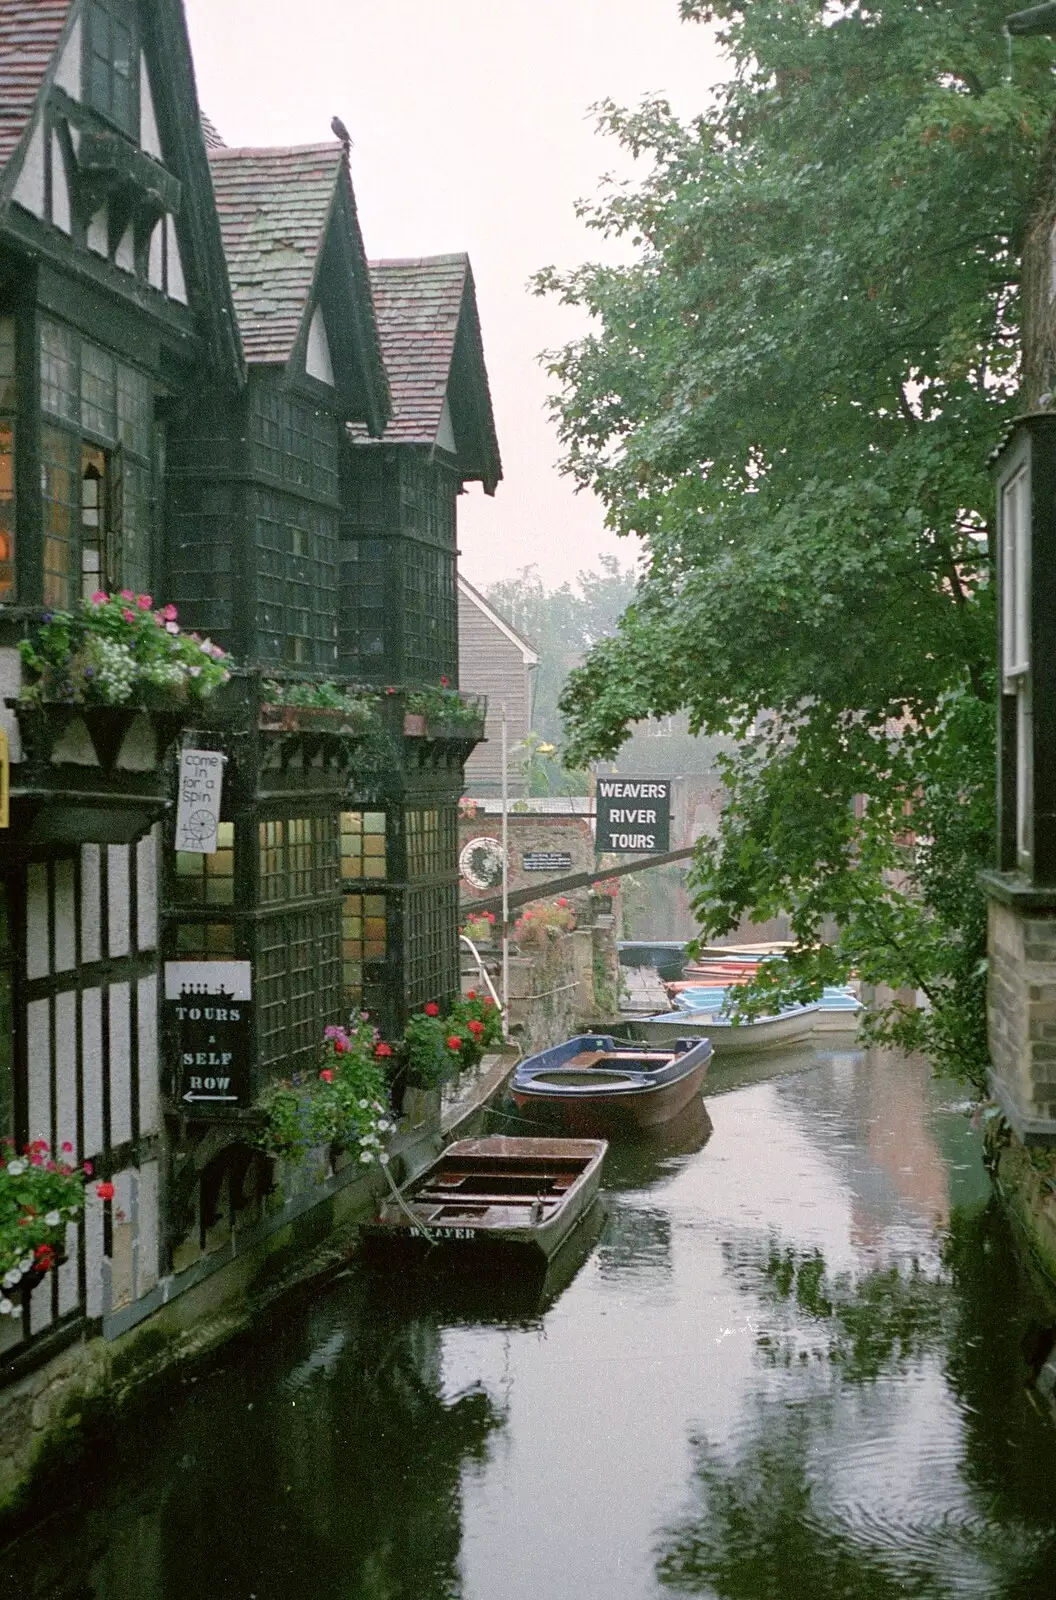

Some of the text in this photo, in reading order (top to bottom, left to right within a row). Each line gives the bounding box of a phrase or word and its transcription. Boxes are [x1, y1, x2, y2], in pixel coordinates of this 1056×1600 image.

[185, 755, 218, 767] come
[183, 776, 215, 789] for a
[600, 783, 666, 798] WEAVERS
[183, 790, 212, 808] spin
[609, 809, 656, 823] RIVER
[609, 833, 655, 848] TOURS
[175, 1007, 240, 1021] TOURS
[183, 1052, 233, 1065] SELF
[190, 1076, 231, 1090] ROW
